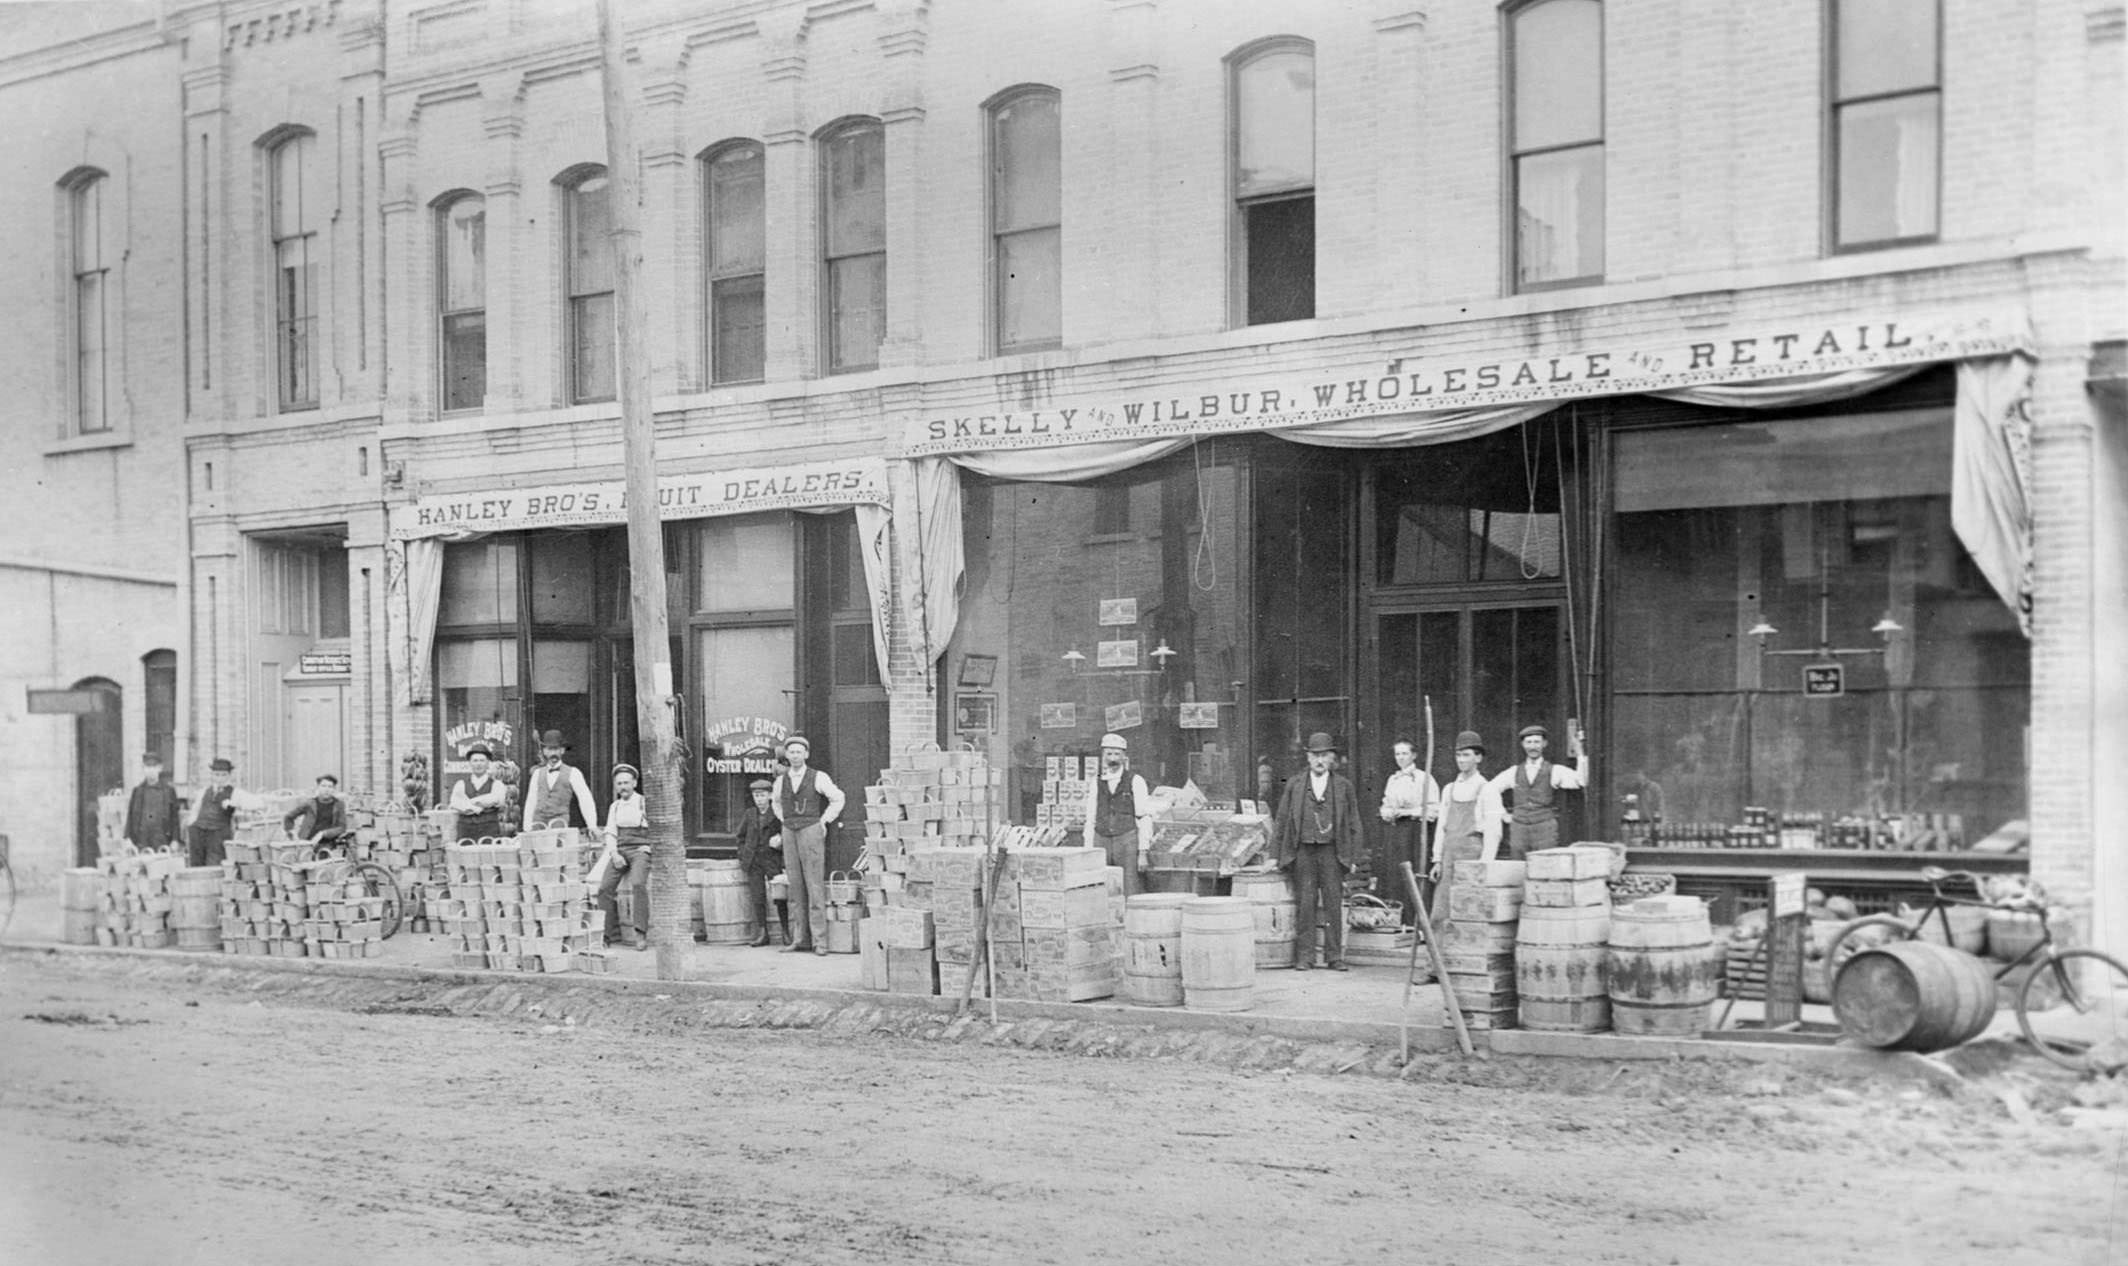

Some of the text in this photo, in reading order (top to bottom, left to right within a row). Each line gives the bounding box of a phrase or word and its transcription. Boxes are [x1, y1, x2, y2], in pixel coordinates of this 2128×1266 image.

[929, 408, 1078, 441] SKELLY
[1313, 355, 1610, 407] WHOLESALE
[417, 500, 513, 525] HANLEY
[619, 485, 702, 509] UIT
[707, 716, 750, 745] HANLEY
[706, 756, 741, 774] OYSTER
